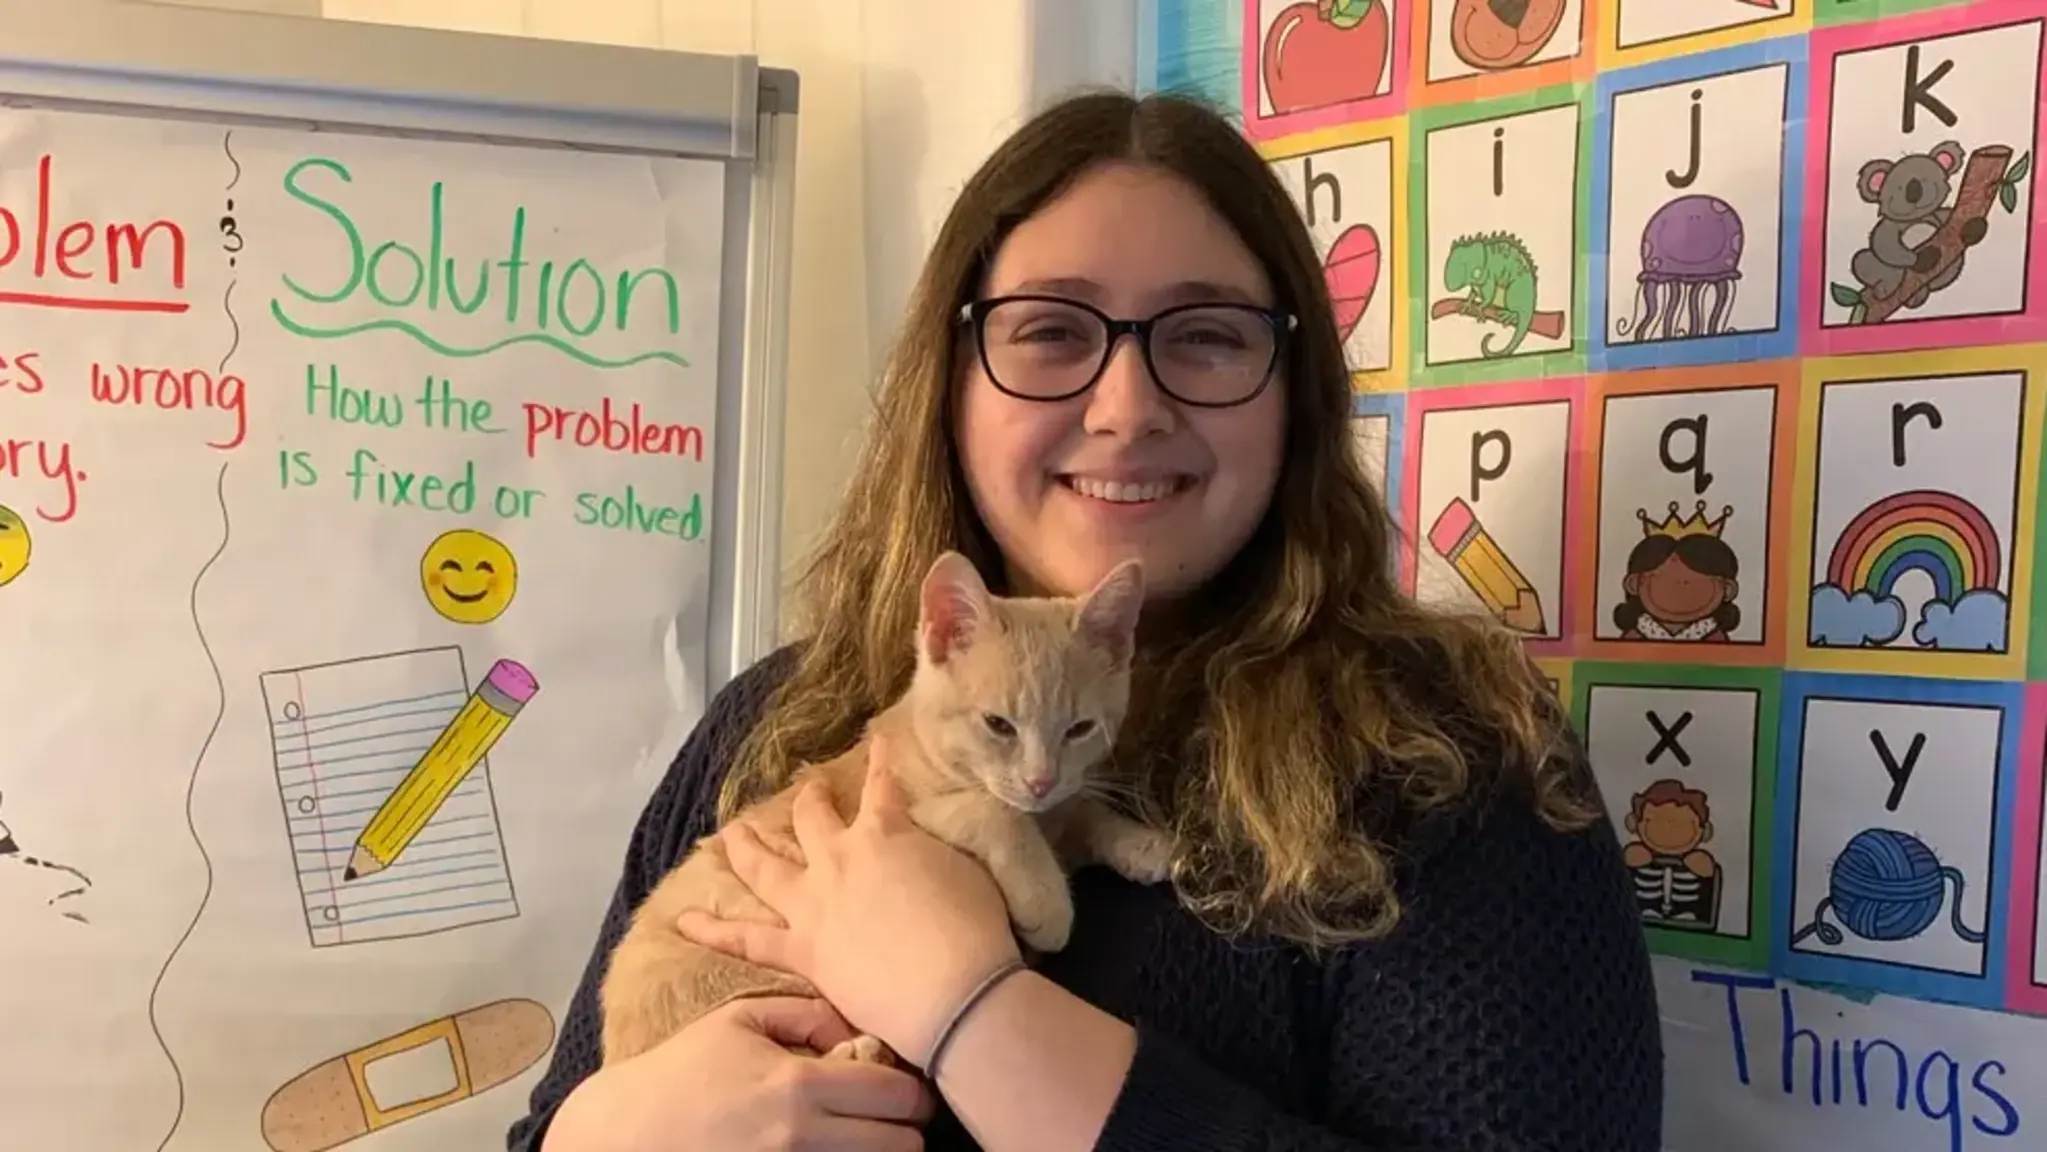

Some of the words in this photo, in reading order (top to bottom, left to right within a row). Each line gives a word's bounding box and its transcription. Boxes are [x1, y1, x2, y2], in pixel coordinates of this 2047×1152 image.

[1901, 45, 1958, 134] k
[1491, 127, 1505, 197] i
[1664, 89, 1703, 189] j
[1304, 157, 1341, 227] h
[282, 157, 680, 336] Solution
[91, 362, 247, 450] wrong
[306, 364, 403, 428] How
[415, 375, 507, 434] the
[522, 397, 703, 462] problem
[1891, 402, 1943, 468] r
[0, 438, 88, 523] ry.
[280, 450, 318, 490] is
[345, 449, 476, 515] fixed
[494, 485, 546, 519] or
[1471, 429, 1512, 503] p
[1659, 413, 1714, 495] q
[1645, 710, 1693, 767] x
[1869, 729, 1927, 812] y
[1690, 968, 2020, 1152] Things
